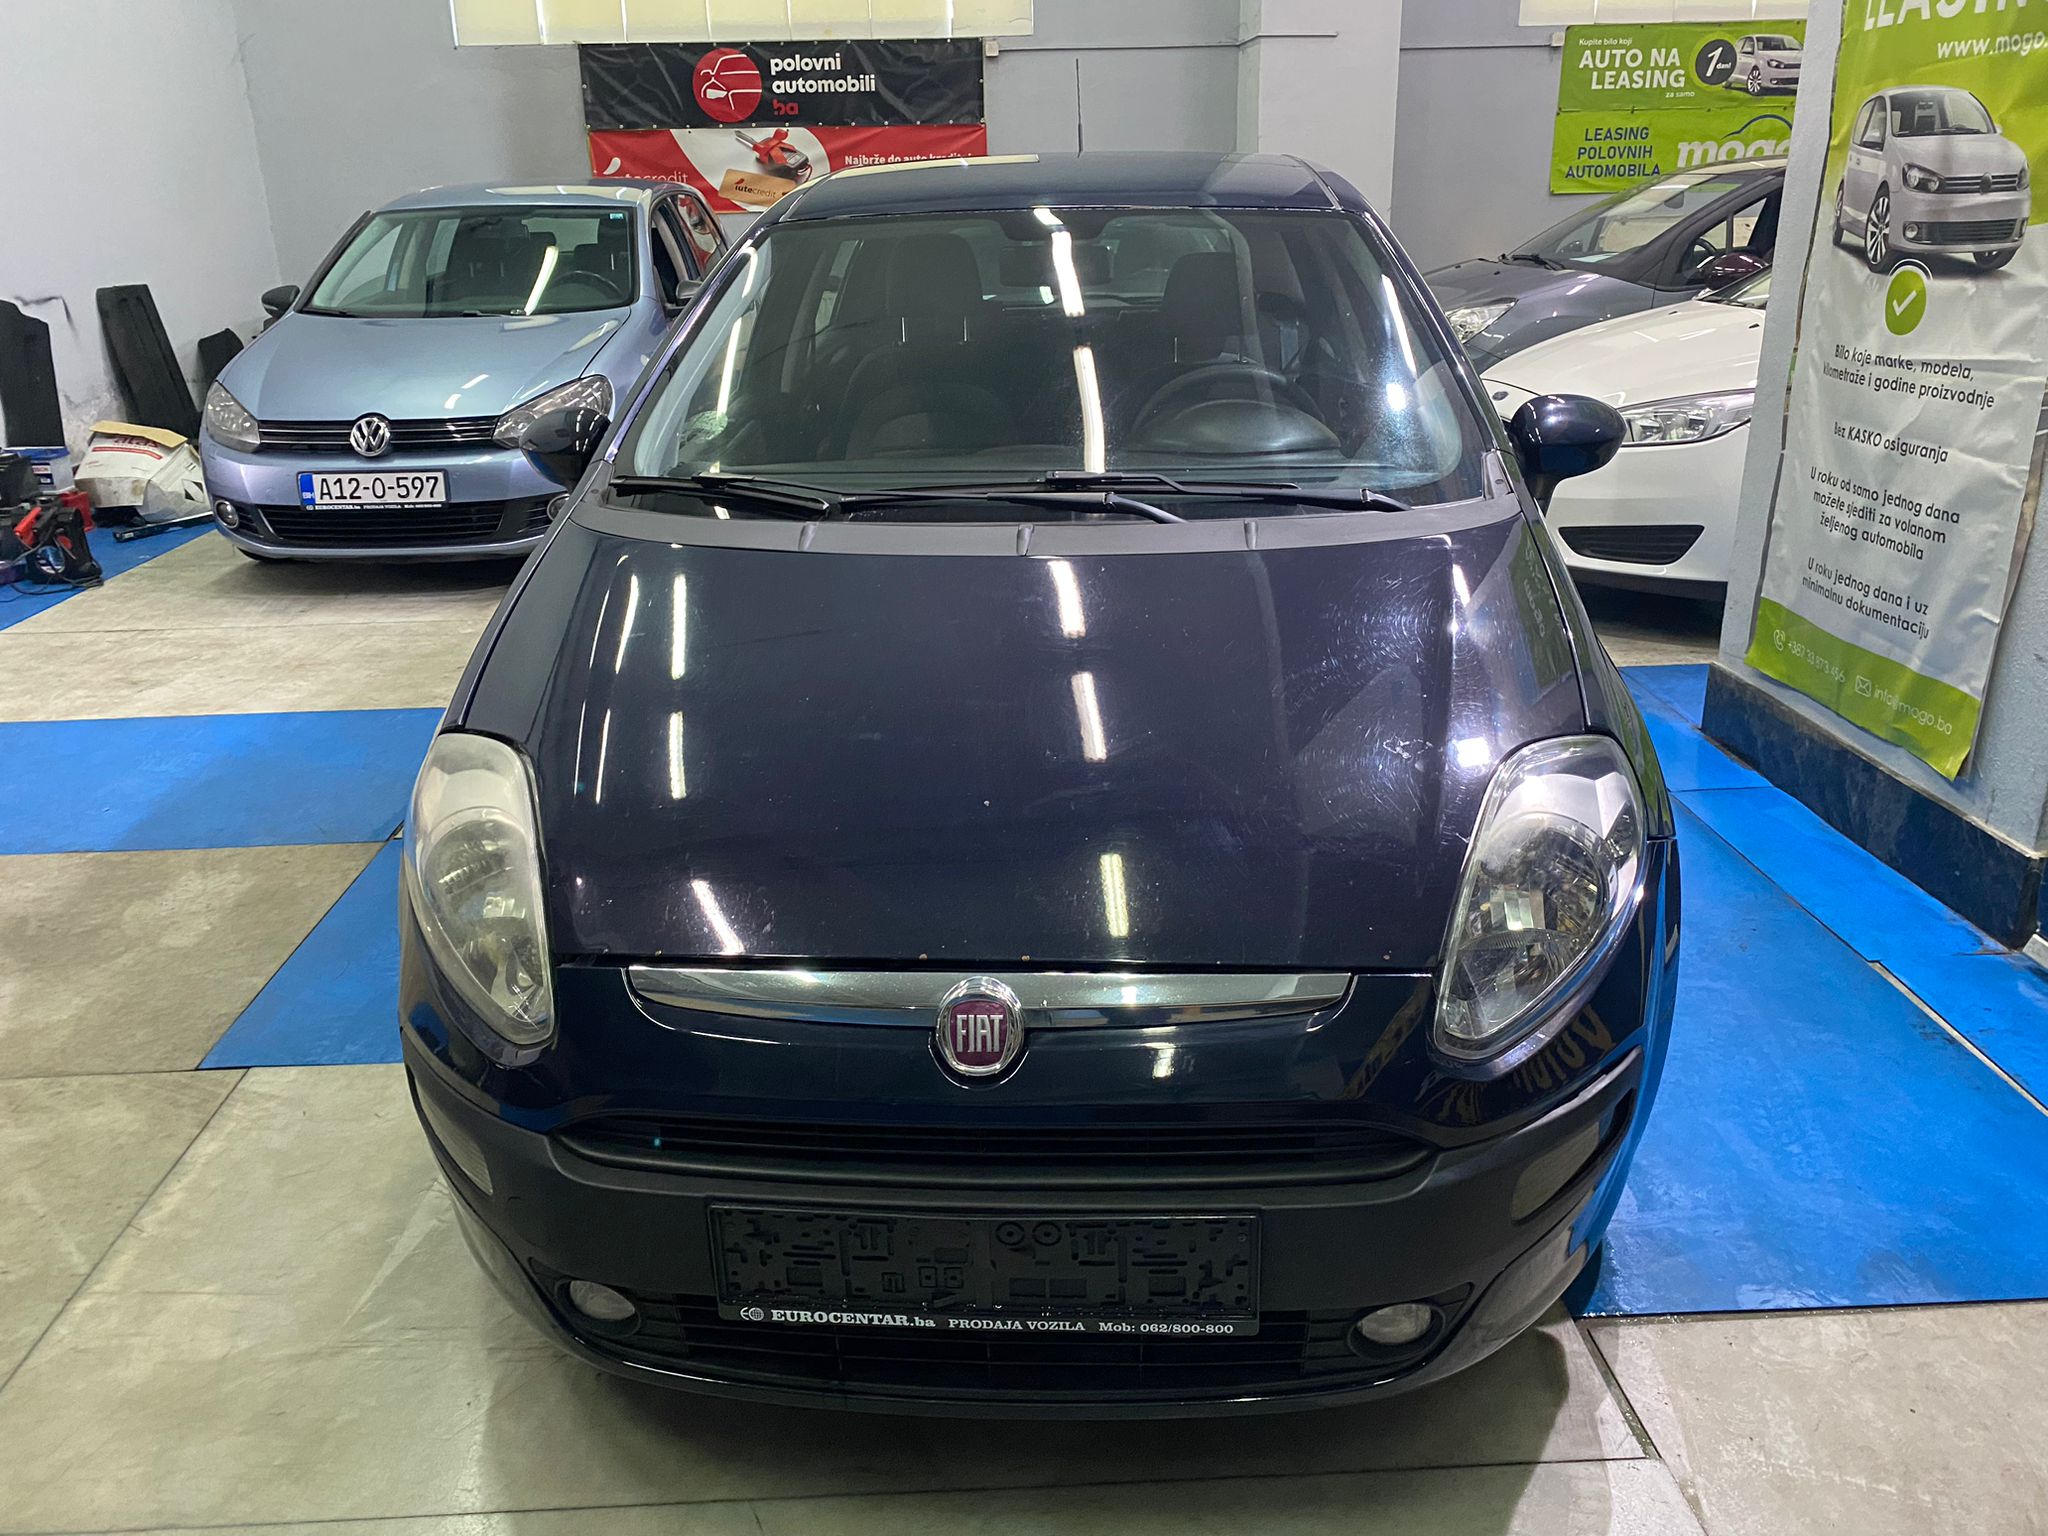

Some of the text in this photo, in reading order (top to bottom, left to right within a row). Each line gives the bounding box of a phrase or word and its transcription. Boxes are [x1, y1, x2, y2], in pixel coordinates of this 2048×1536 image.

[1579, 38, 1602, 46] Kupite
[1619, 37, 1633, 46] koji
[770, 53, 841, 76] polovni
[1579, 48, 1681, 69] AUTO NA
[1706, 46, 1723, 77] 1
[772, 74, 876, 94] automobili
[1591, 69, 1685, 90] LEASING
[1585, 126, 1649, 142] LEASING
[845, 153, 885, 166] Najbrže
[887, 154, 901, 163] do
[1577, 145, 1653, 160] POLOVNIH
[1565, 163, 1661, 179] AUTOMOBILA
[1834, 343, 1975, 382] Bilo koje marke, modela,
[1867, 372, 1873, 387] i
[1873, 376, 1917, 394] godine
[1918, 384, 1995, 411] proizvodnje
[1847, 426, 1883, 447] KASKO
[1883, 437, 1949, 464] osiguranja
[1810, 466, 1960, 524] U roku od samo jednog dana
[1813, 491, 1946, 544] možete sjediti za volanom
[1820, 511, 1924, 560] željenog automobila
[1807, 556, 1929, 616] U roku jednog dana i uz
[1802, 576, 1930, 640] minimalnu dokumentaciju
[956, 1014, 1004, 1053] FIAT
[771, 1309, 1235, 1335] EUROCENTAR.ba PRODAJA VOZILA Mob: 062/800-800
